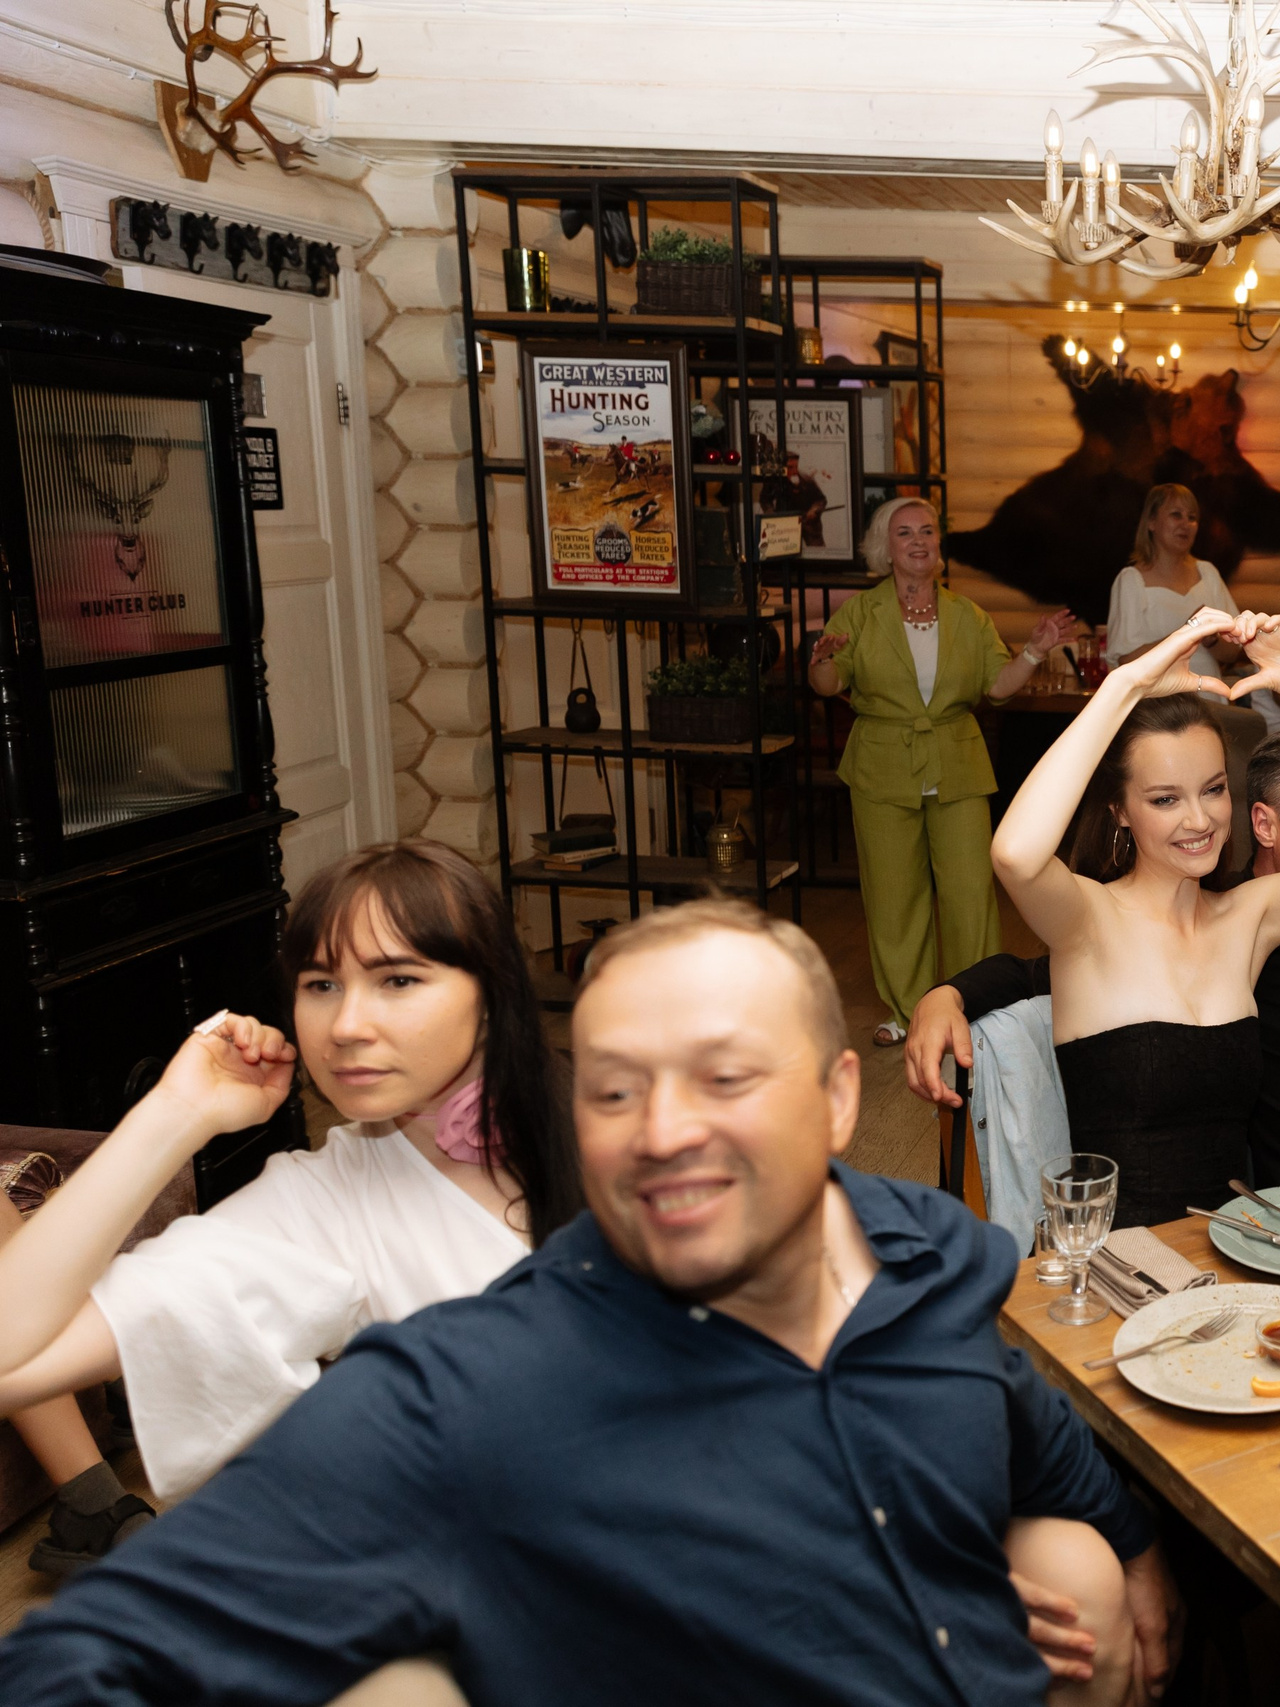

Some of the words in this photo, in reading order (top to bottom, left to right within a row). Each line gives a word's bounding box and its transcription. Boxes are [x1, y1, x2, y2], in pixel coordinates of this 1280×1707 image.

[541, 365, 589, 380] GREAT
[592, 366, 664, 382] WESTERN
[550, 388, 650, 413] HUNTING
[554, 534, 589, 542] HUNTING
[557, 542, 590, 550] SEASON
[558, 551, 591, 560] TICKETS
[80, 597, 144, 617] HUNTER
[148, 593, 186, 611] CLUB
